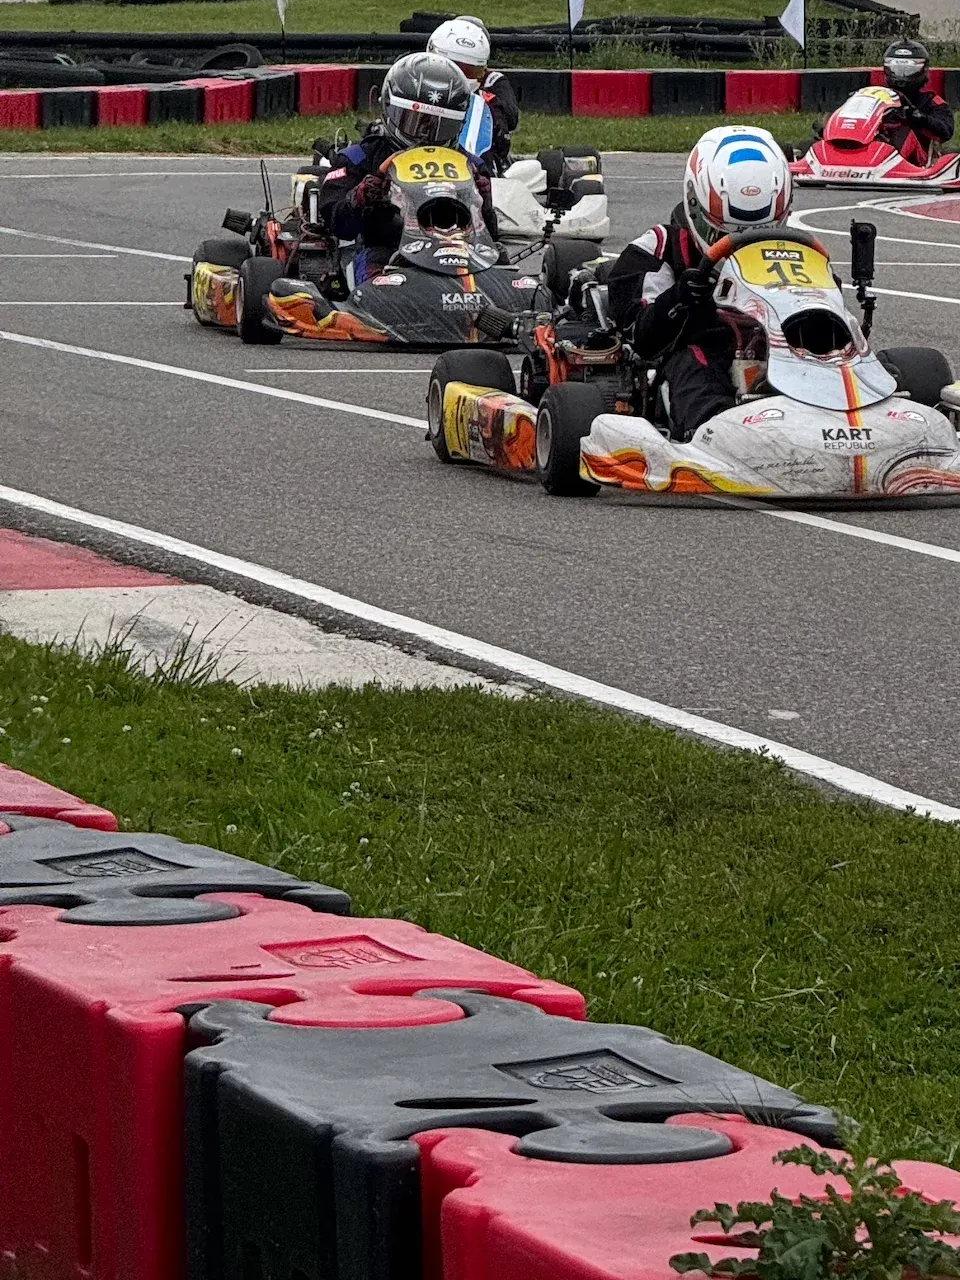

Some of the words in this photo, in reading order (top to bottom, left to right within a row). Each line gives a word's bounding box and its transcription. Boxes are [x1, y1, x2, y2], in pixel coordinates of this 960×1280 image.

[409, 161, 459, 180] 326
[821, 168, 875, 180] birelart
[764, 249, 801, 260] KMR
[439, 257, 469, 267] KMR
[766, 261, 813, 285] 15
[441, 292, 483, 305] KART
[821, 428, 873, 441] KART
[823, 441, 876, 450] REPUBLIC
